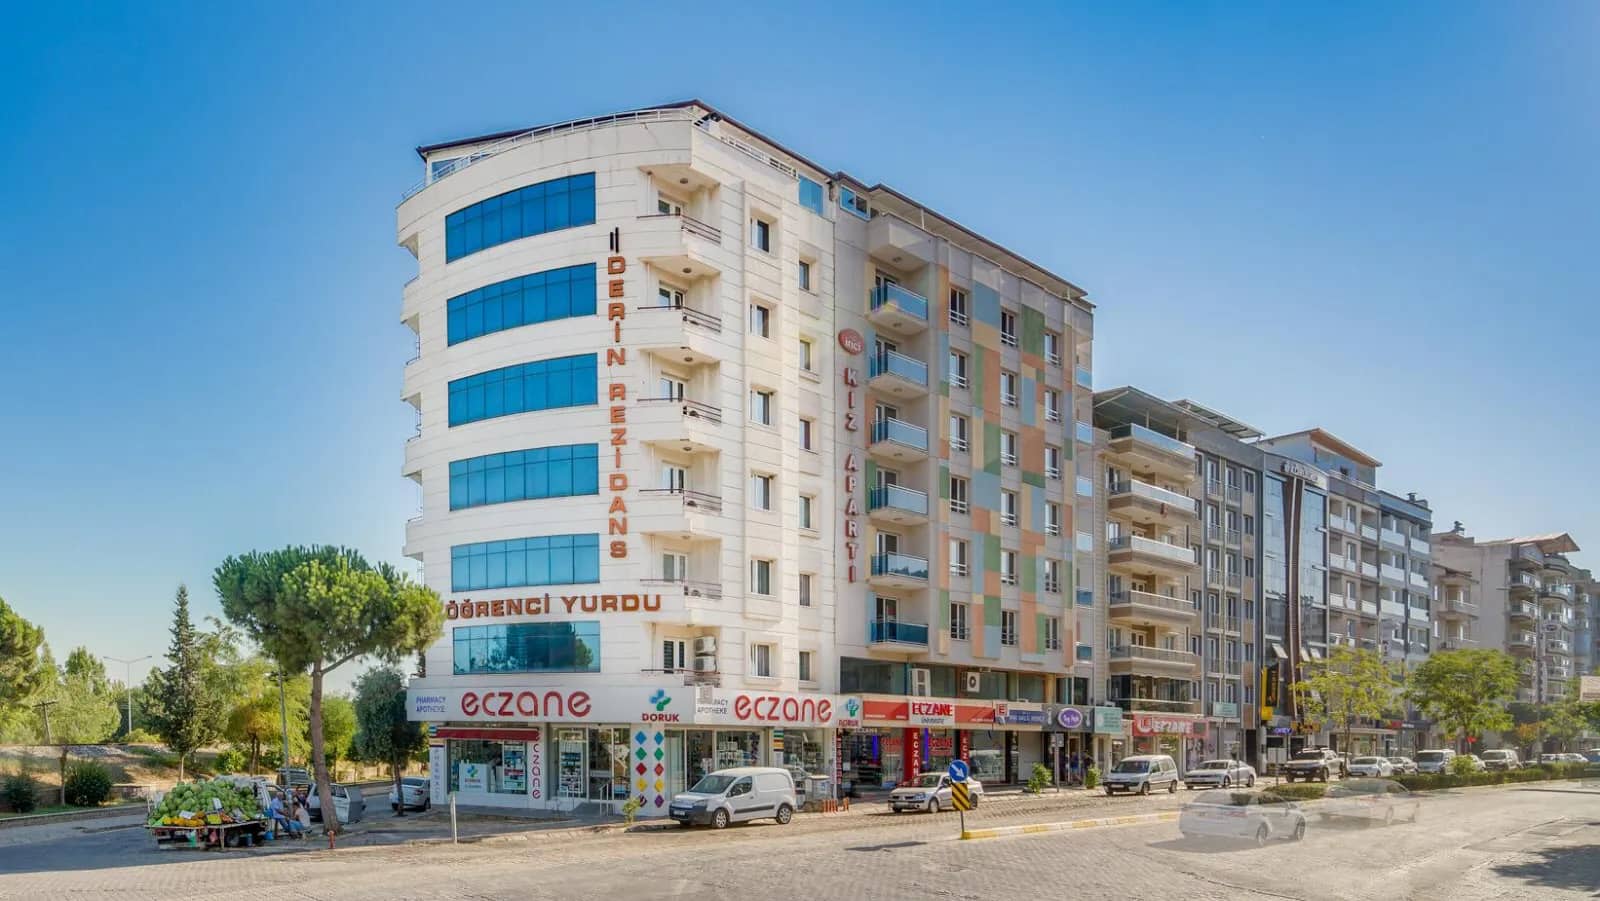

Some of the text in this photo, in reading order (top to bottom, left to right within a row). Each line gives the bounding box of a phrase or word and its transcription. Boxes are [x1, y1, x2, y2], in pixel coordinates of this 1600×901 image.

[608, 383, 629, 559] REZİDANS
[446, 592, 661, 620] ÖĞRENCİ YURDU
[461, 690, 591, 717] eczane
[735, 695, 832, 723] eczane
[912, 702, 953, 717] ECZANE
[641, 713, 680, 722] DORUK
